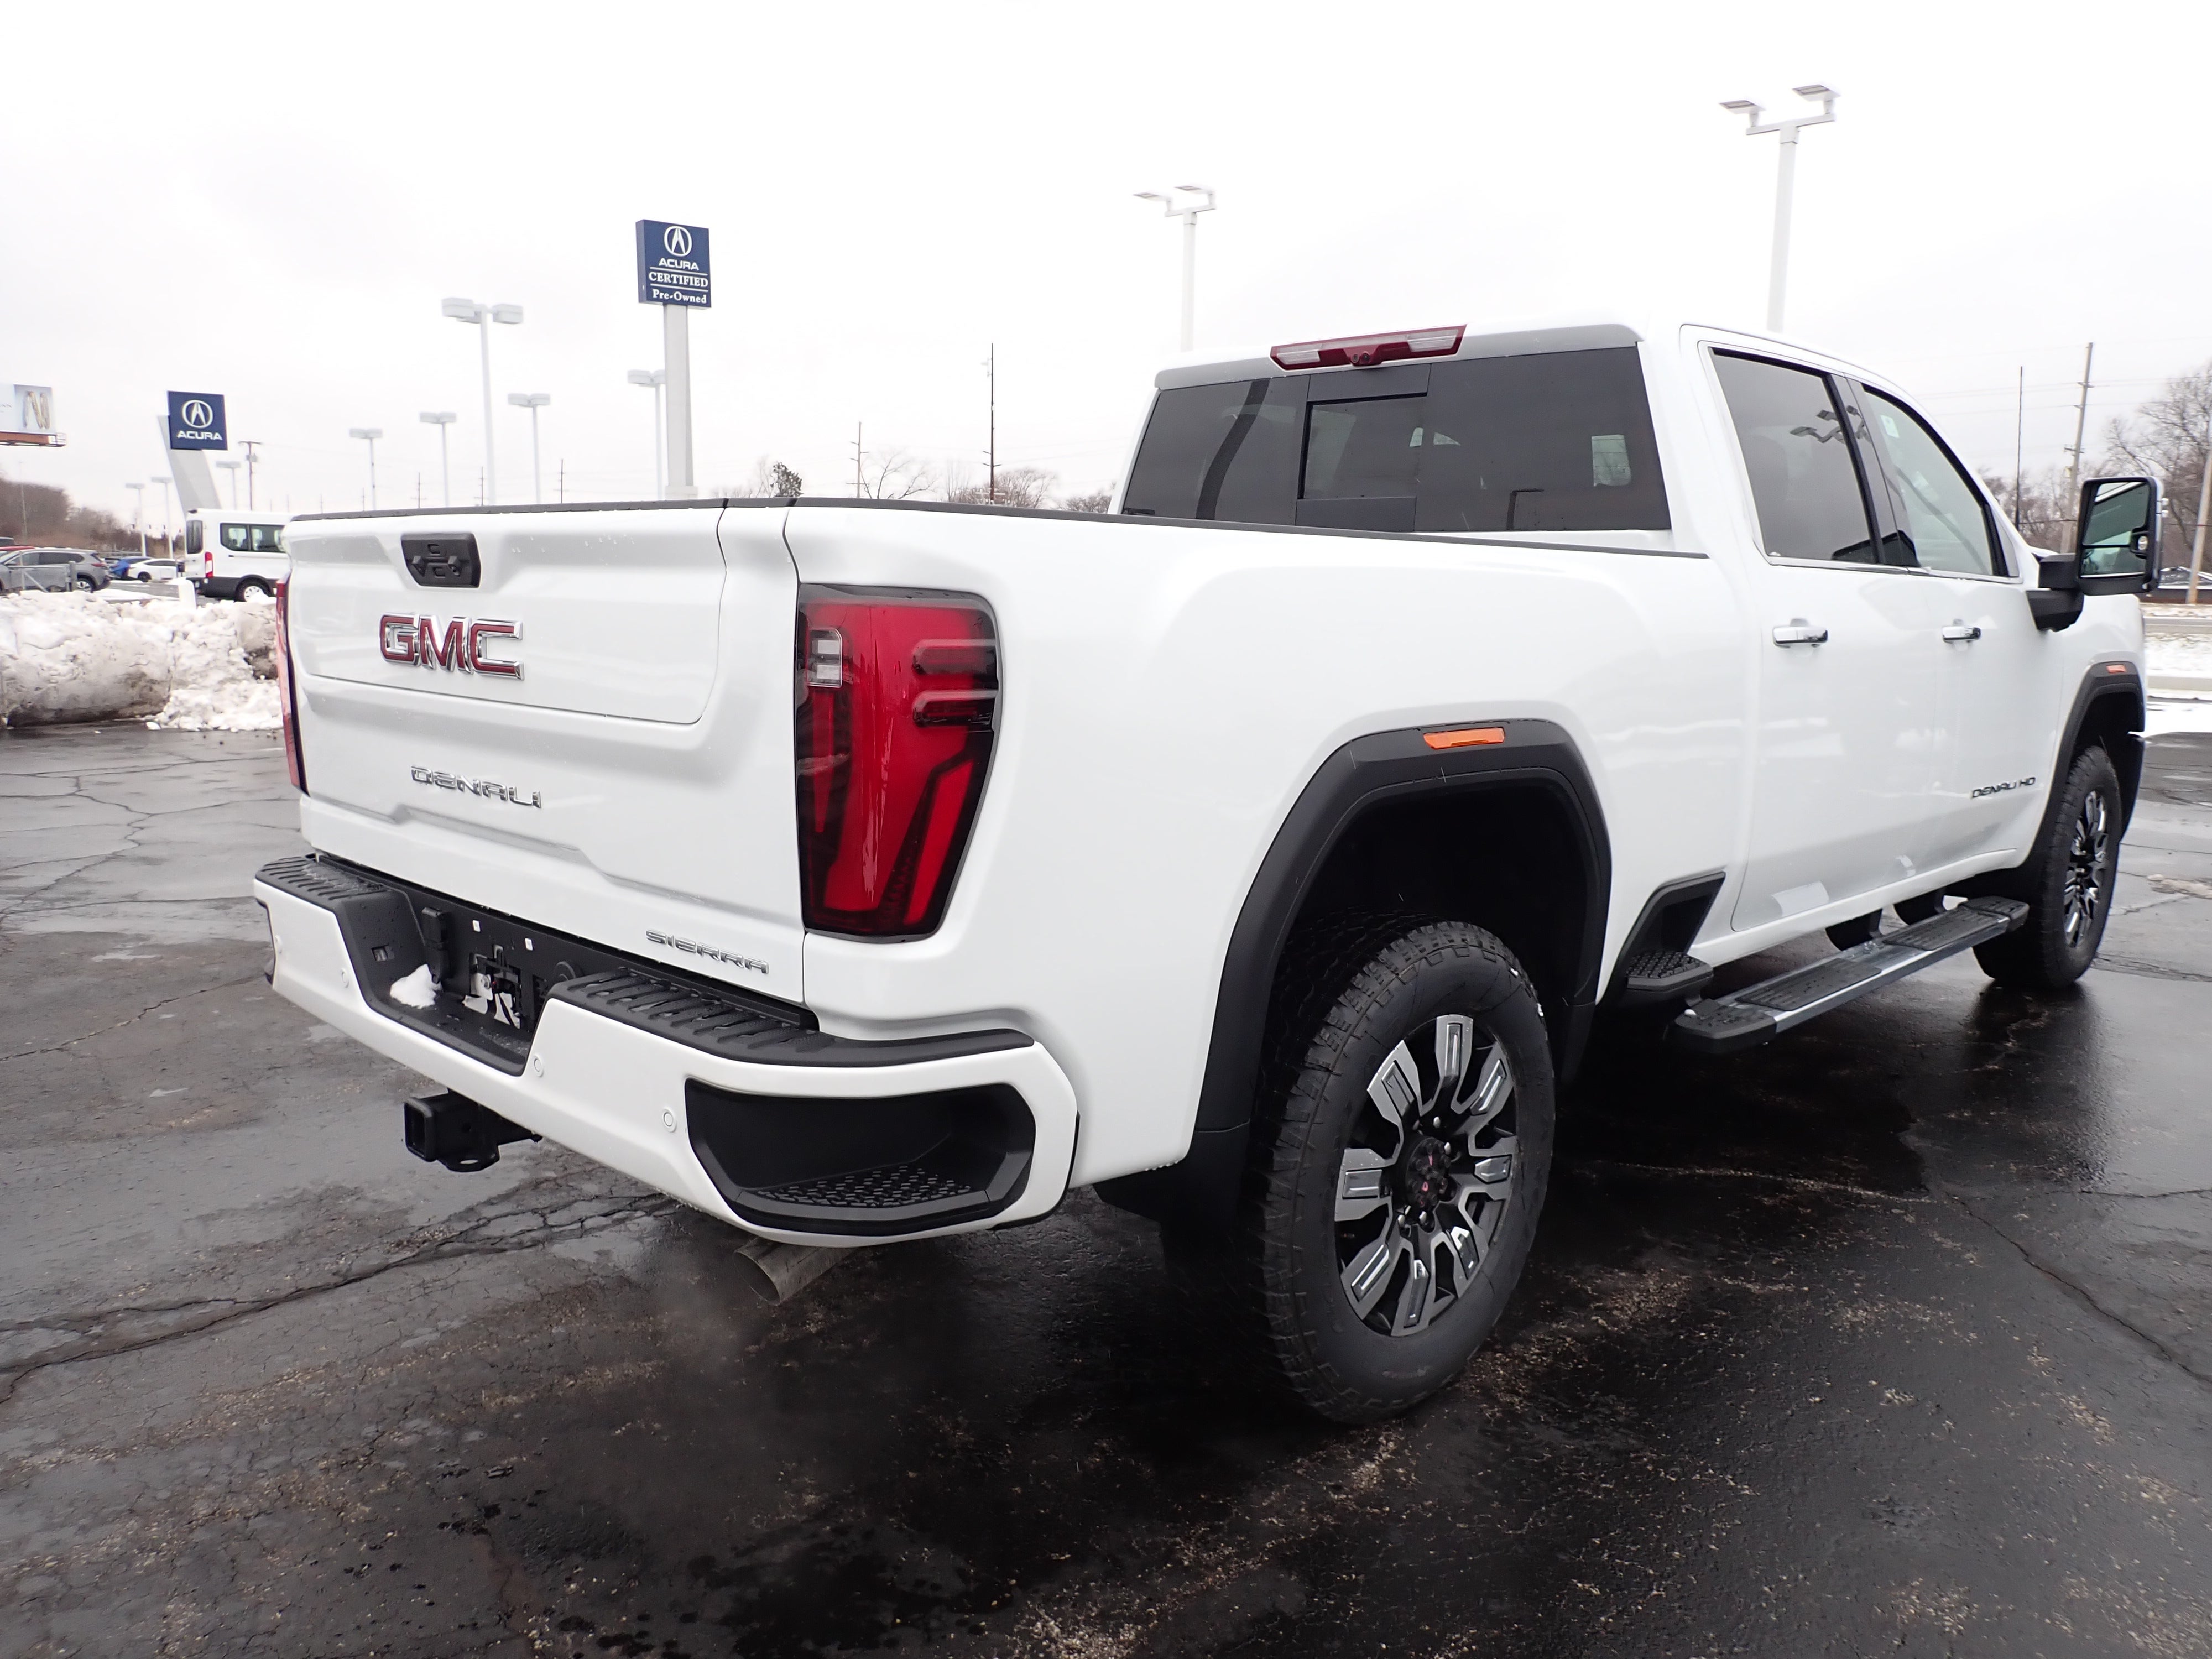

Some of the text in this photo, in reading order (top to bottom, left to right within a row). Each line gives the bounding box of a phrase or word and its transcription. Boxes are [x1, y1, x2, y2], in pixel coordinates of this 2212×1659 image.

[658, 258, 700, 271] ACURA
[648, 272, 709, 288] CERTIFIED
[652, 289, 707, 304] Pre-Owned
[177, 430, 223, 440] ACURA
[379, 613, 525, 681] GMC
[411, 765, 542, 809] DENALI
[1970, 776, 2036, 799] DENALI HD
[645, 929, 769, 974] SIERRA
